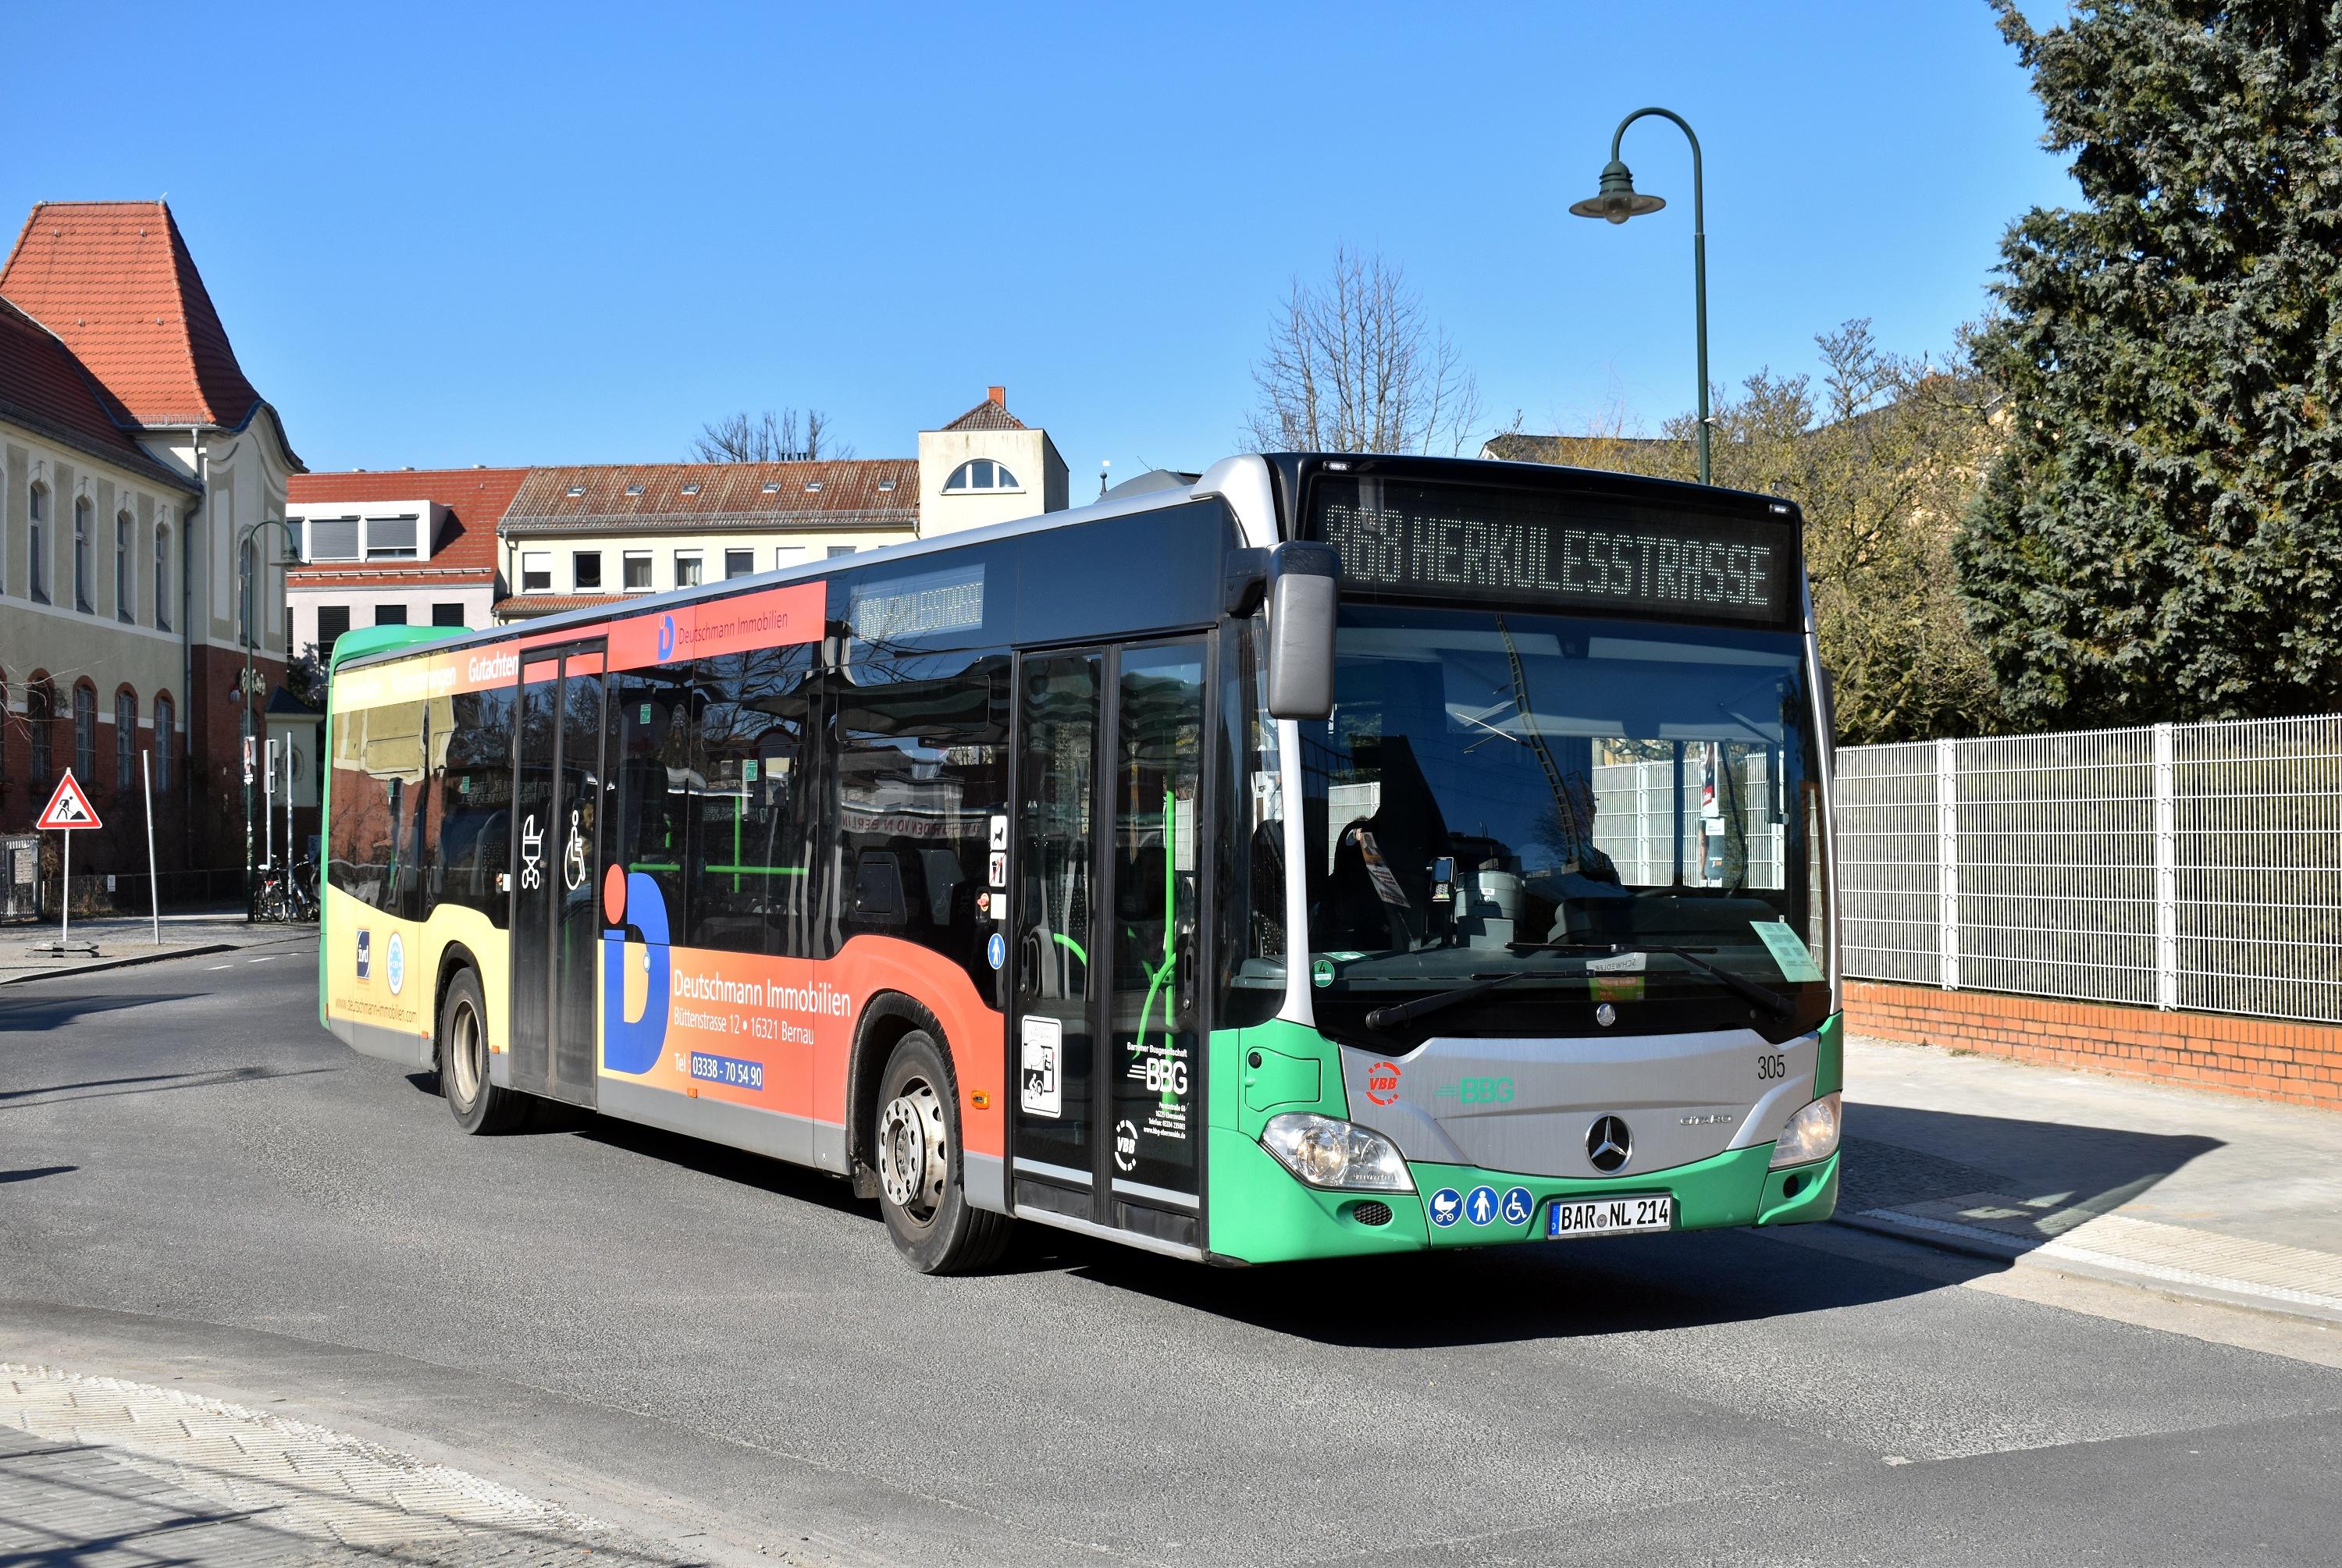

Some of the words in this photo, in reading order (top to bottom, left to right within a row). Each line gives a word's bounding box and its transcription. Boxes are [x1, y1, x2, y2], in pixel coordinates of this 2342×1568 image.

[1411, 516, 1770, 606] HERKULESSTRASSE
[678, 621, 735, 645] Deutschmann
[738, 610, 788, 634] Immobilien
[468, 651, 518, 682] Gutachten
[1319, 962, 1326, 974] 4
[674, 969, 762, 1006] Deutschmann
[767, 979, 851, 1017] Immobilien
[674, 1006, 727, 1033] Büttenstrasse
[729, 1014, 740, 1034] 12
[751, 1017, 778, 1040] 16321
[781, 1021, 814, 1044] Bernau
[1127, 1041, 1149, 1054] Barnimer
[1149, 1044, 1187, 1058] Busgesellschaft
[692, 1056, 717, 1079] 03338
[724, 1062, 736, 1082] 70
[738, 1065, 749, 1084] 54
[751, 1066, 762, 1087] 90
[1146, 1058, 1188, 1095] BBG
[1757, 1054, 1785, 1080] 305
[1369, 1077, 1397, 1090] VBB
[1461, 1076, 1515, 1104] BBG
[1116, 1136, 1136, 1154] VBB
[1561, 1204, 1596, 1231] BAR
[1610, 1203, 1632, 1227] NL
[1636, 1200, 1668, 1225] 214
